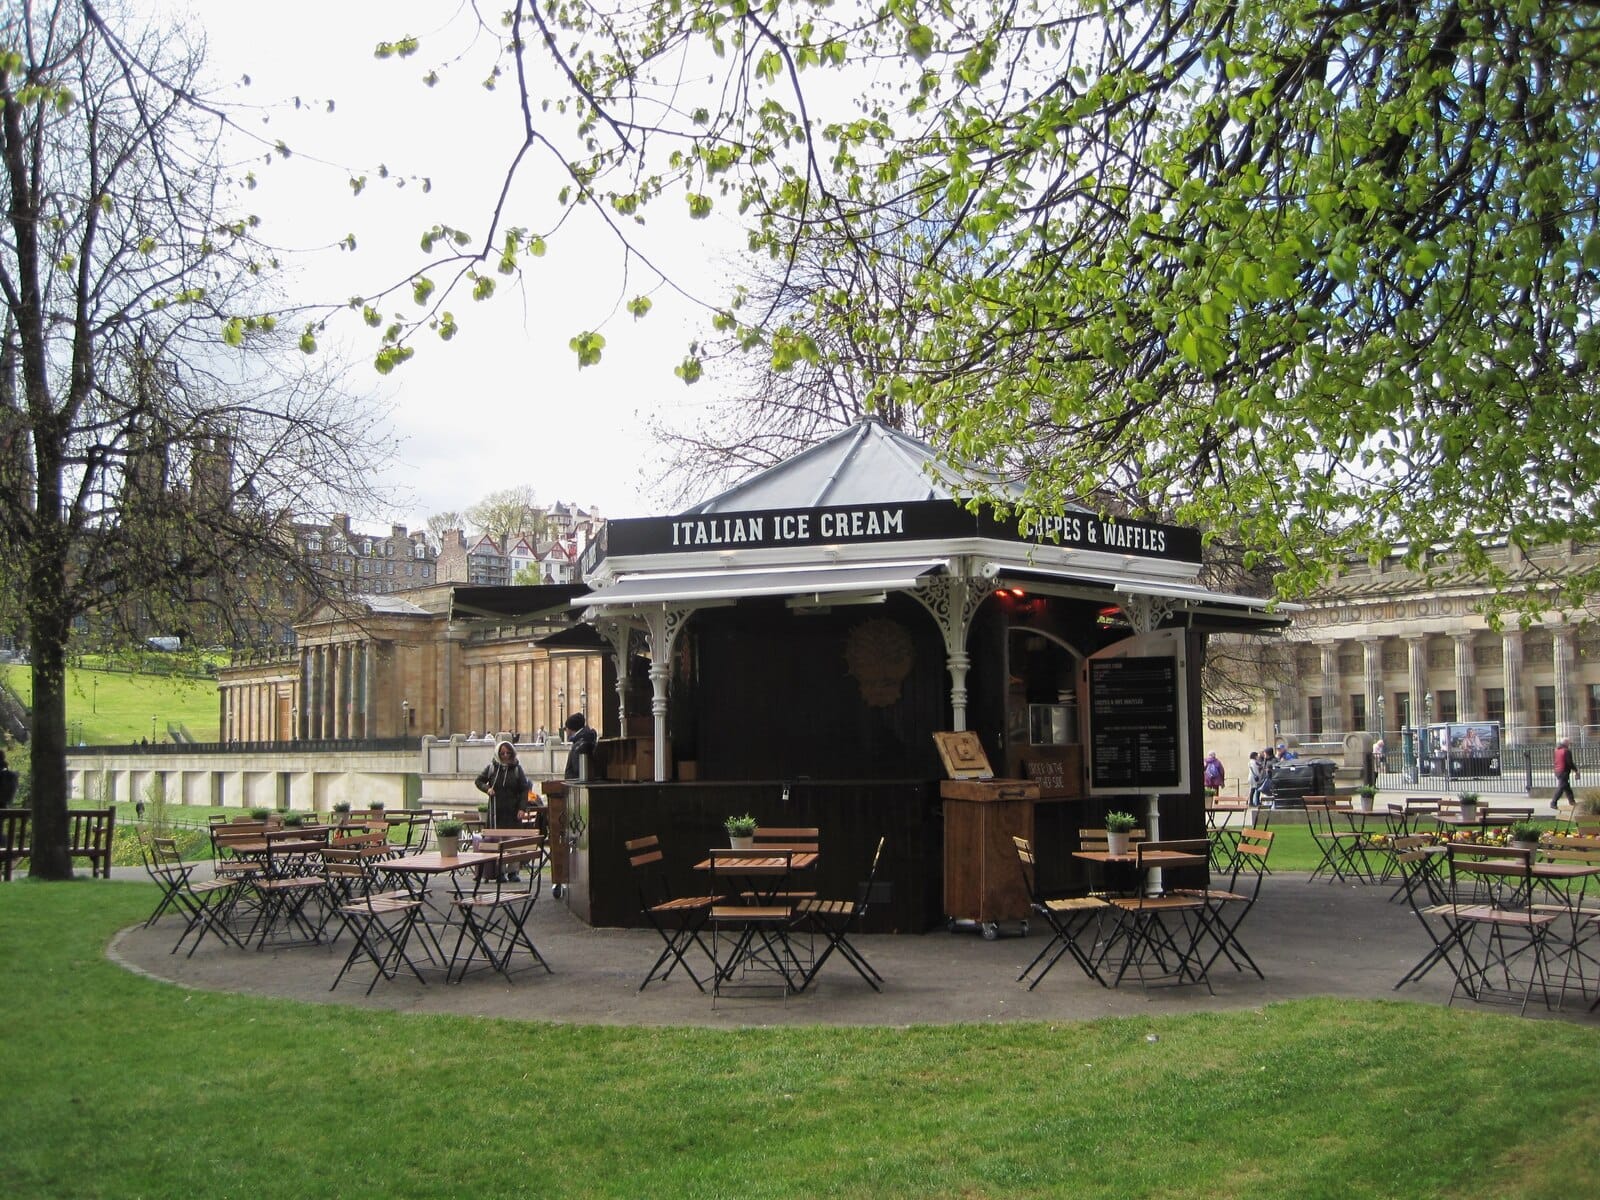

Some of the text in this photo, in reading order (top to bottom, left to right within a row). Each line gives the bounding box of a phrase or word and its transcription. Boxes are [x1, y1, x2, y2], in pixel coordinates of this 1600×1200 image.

[672, 509, 904, 545] ITALIAN ICE CREAM
[1087, 520, 1097, 544] &
[1102, 522, 1166, 552] WAFFLES
[1207, 704, 1252, 716] National
[1207, 719, 1244, 732] Gallery
